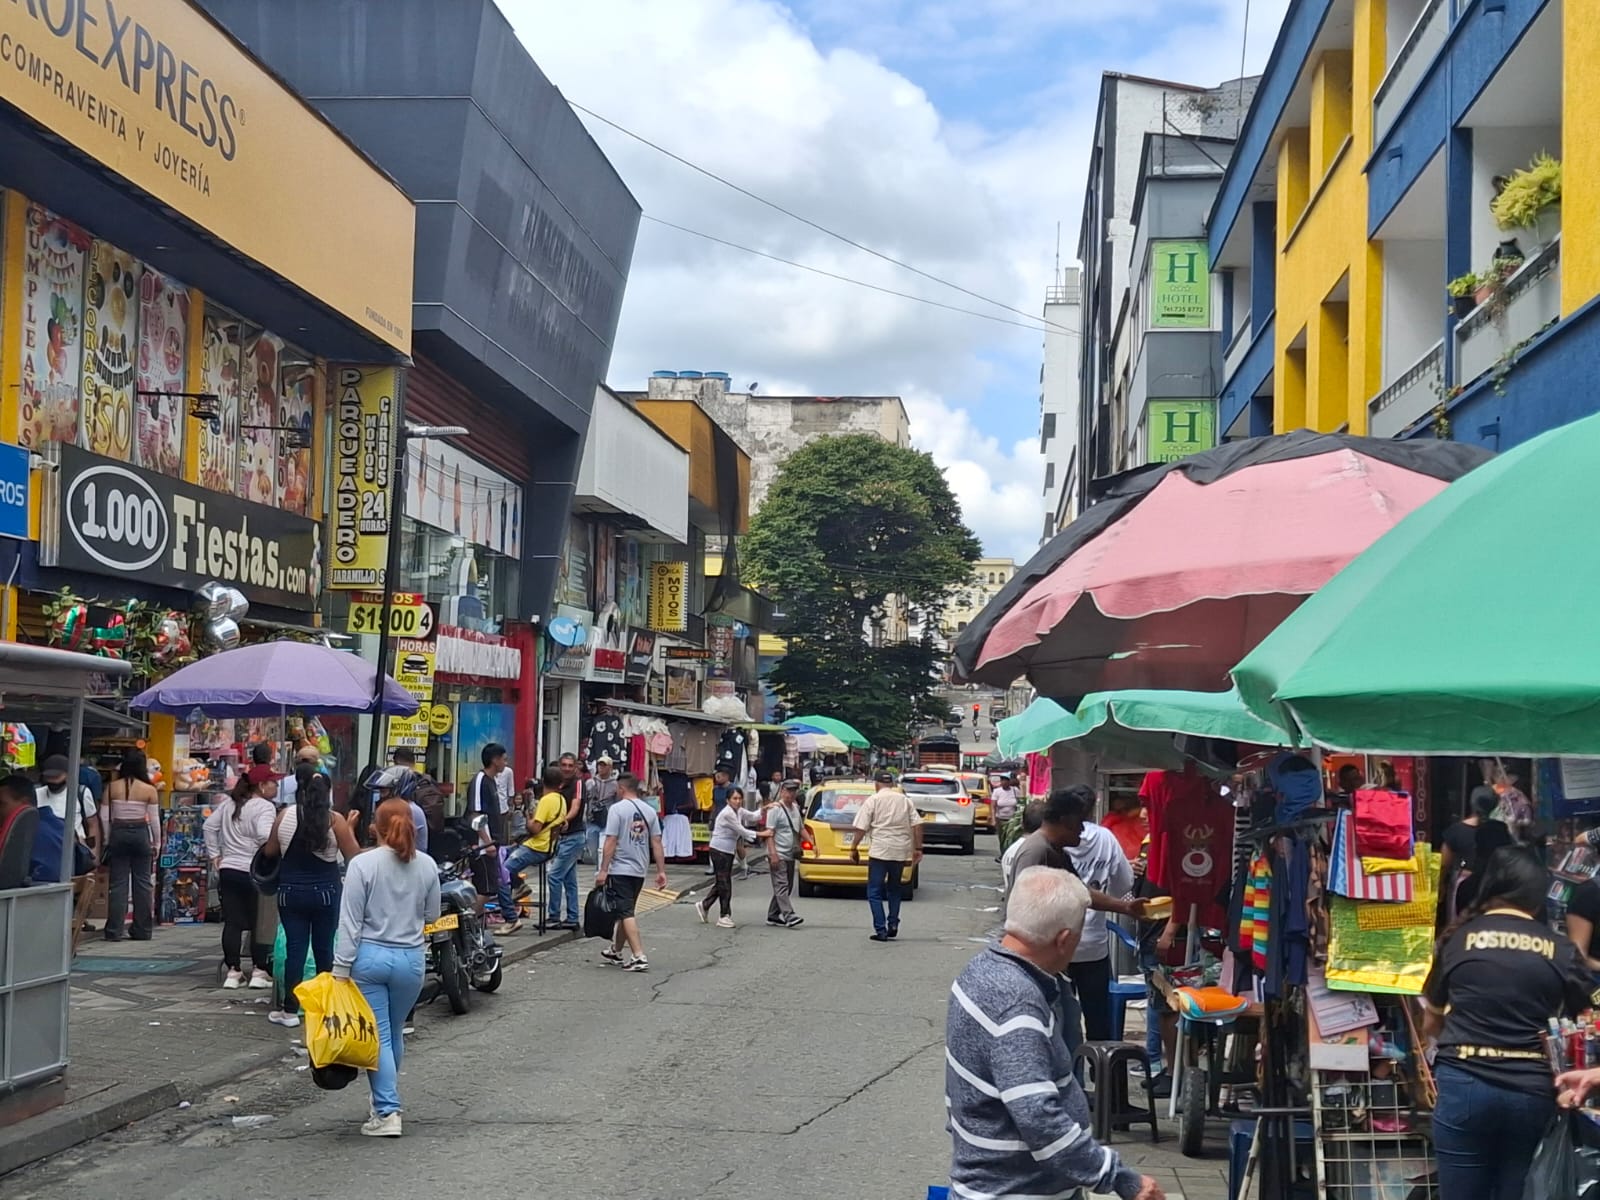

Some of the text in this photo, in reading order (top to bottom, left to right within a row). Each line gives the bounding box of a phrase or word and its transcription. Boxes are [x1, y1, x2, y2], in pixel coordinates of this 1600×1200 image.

[1, 33, 211, 197] COMPRAVENTA Y JOYERÍA
[1165, 252, 1199, 284] H
[378, 396, 390, 489] CARROS
[1162, 411, 1201, 443] H
[365, 413, 378, 483] MOTOS
[337, 368, 361, 564] PARQUEADERO
[82, 481, 158, 550] 1.000
[362, 490, 385, 520] 24
[360, 519, 387, 534] HORAS
[173, 494, 307, 595] Fiestas.com
[333, 569, 377, 584] JARAMILLO
[362, 592, 414, 604] MOOS
[668, 577, 681, 617] MOTOS
[353, 605, 416, 632] $100
[420, 611, 430, 630] 4
[400, 640, 436, 653] HORAS
[391, 722, 412, 731] MOTOS
[1465, 931, 1555, 960] POSTOBON
